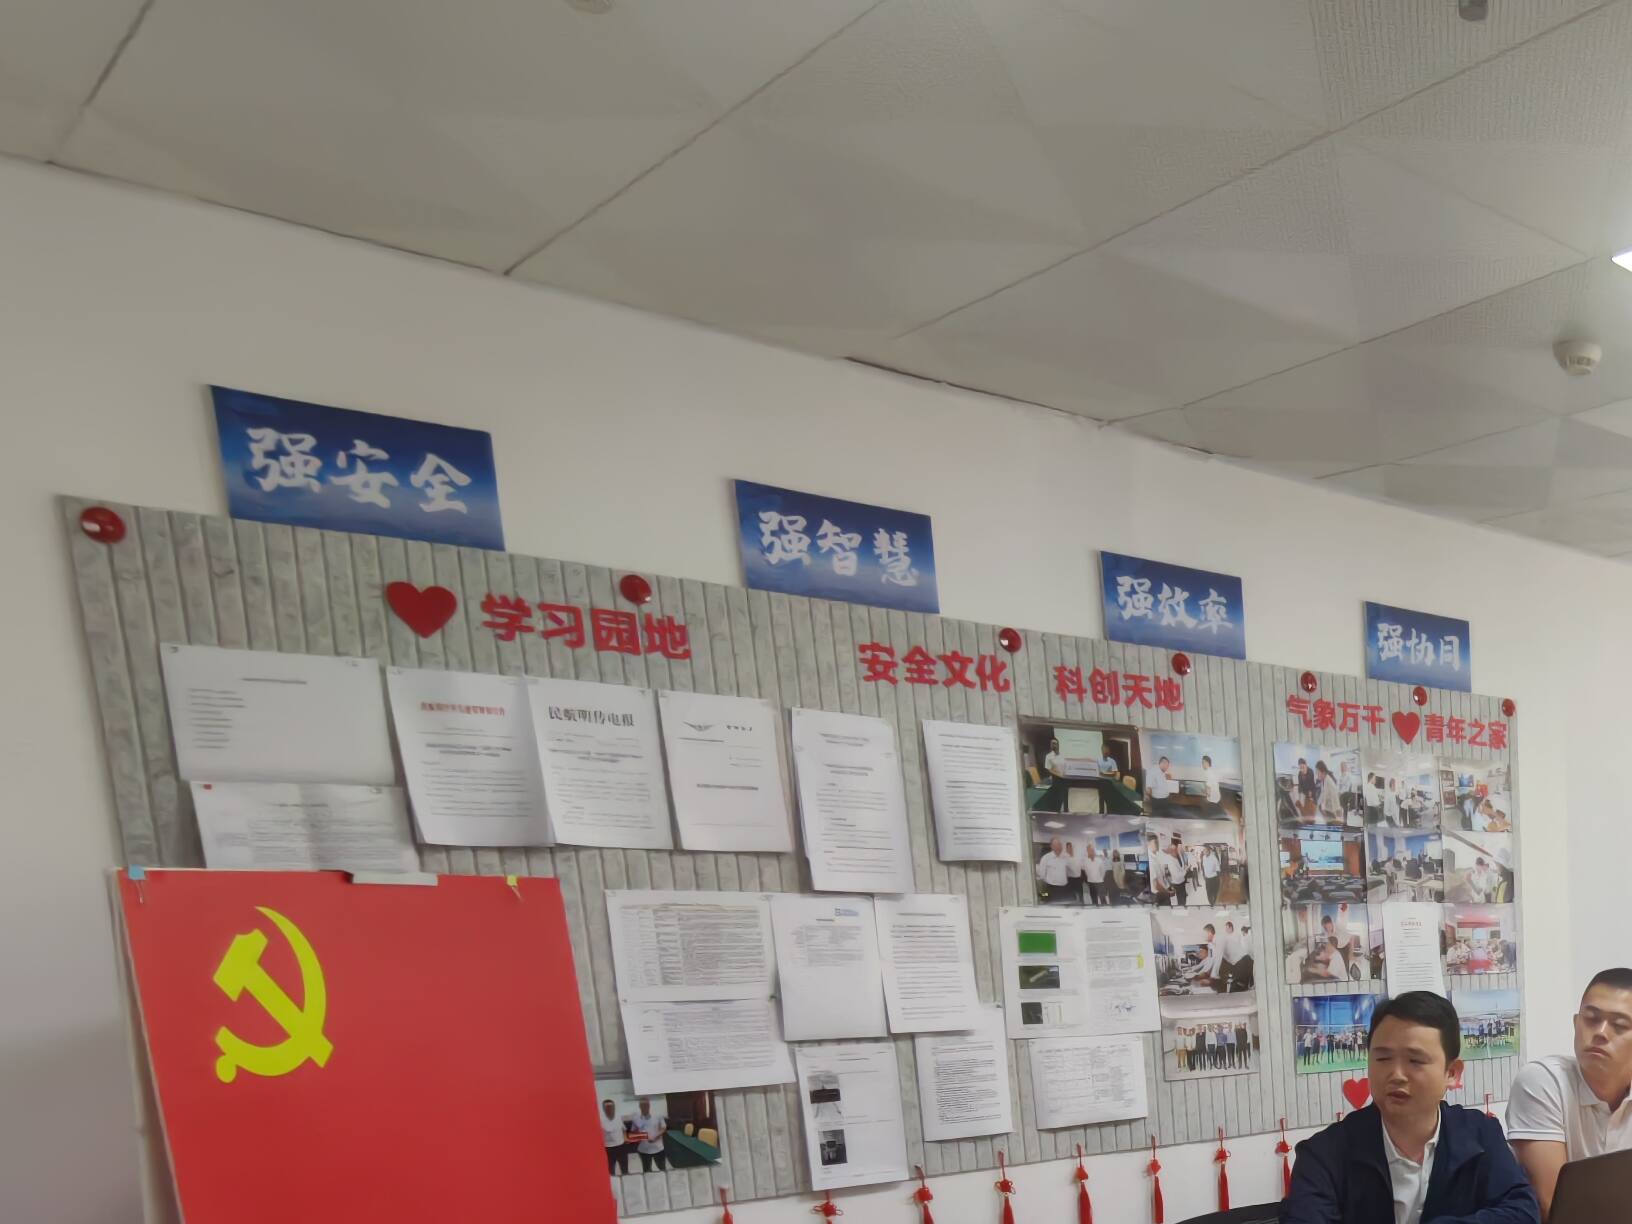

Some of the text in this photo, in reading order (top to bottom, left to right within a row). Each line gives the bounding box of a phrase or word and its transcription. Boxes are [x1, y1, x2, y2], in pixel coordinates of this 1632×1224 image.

[246, 427, 472, 514] 强安全
[758, 511, 919, 587] 强智慧
[480, 592, 692, 660] 学习园地
[1116, 575, 1233, 635] 强效率
[858, 642, 1011, 693] 安全文化
[1377, 622, 1460, 672] 强协同
[1053, 665, 1183, 712] 科创天地
[1286, 694, 1508, 750] 气象万千 青年之家
